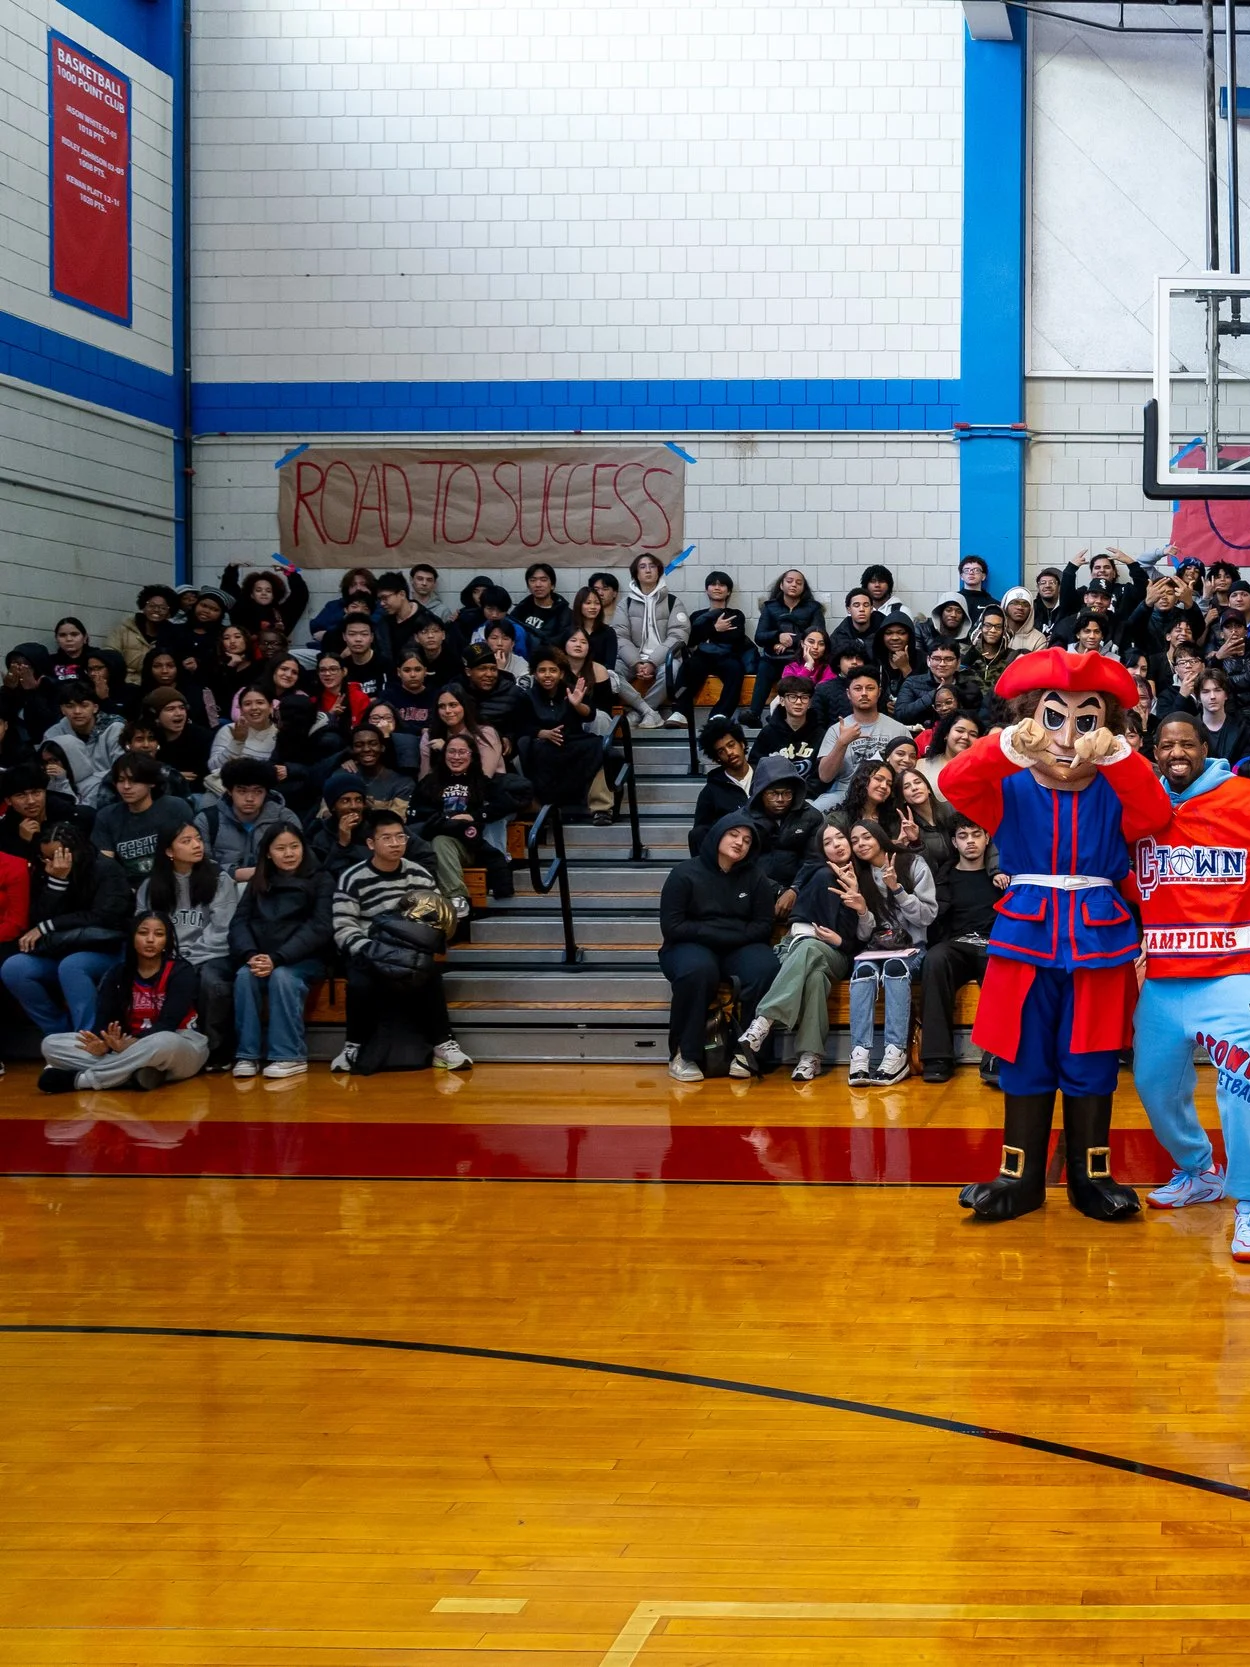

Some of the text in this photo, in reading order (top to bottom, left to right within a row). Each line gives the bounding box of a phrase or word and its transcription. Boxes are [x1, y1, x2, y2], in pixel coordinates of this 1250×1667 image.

[57, 48, 123, 99] BASKETBALL
[57, 65, 125, 113] 1000 POINT CLUB
[293, 460, 673, 549] ROAD TO SUCCESS
